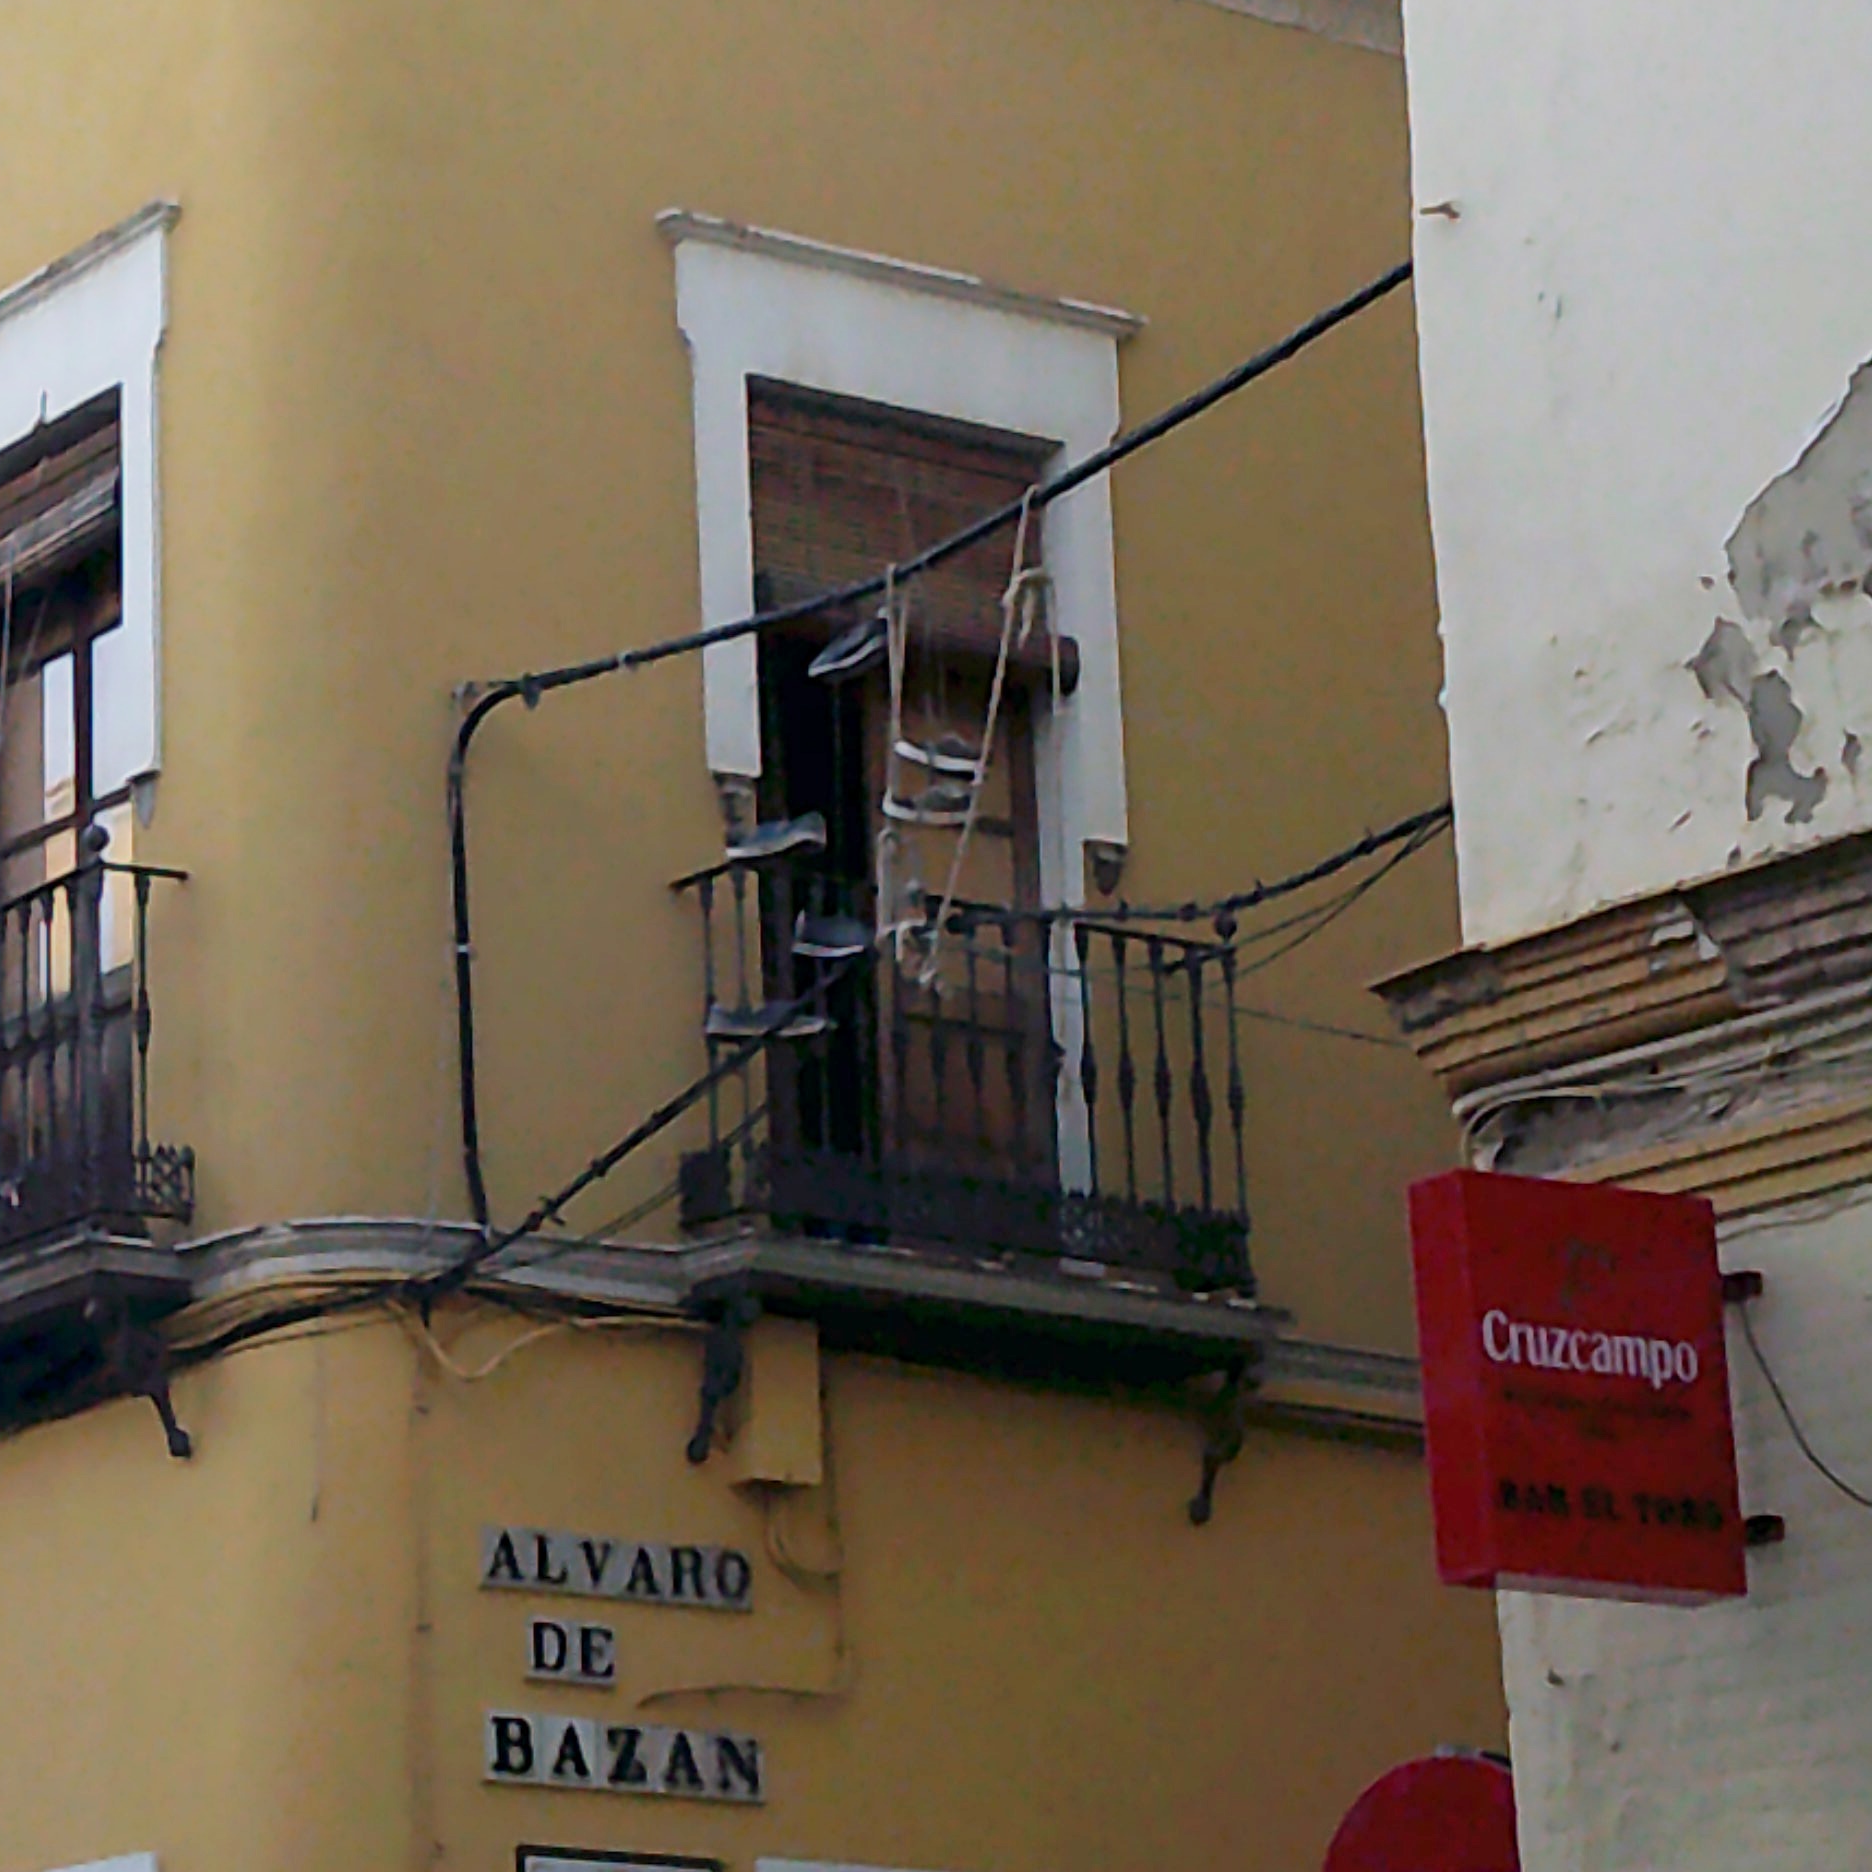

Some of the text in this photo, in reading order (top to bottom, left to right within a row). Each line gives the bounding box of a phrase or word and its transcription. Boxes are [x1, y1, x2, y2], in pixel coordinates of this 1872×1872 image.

[1482, 1309, 1699, 1389] Cruzcampo
[486, 1529, 752, 1600] ALVARO
[532, 1621, 615, 1677] DE
[491, 1715, 760, 1794] BAZAN
